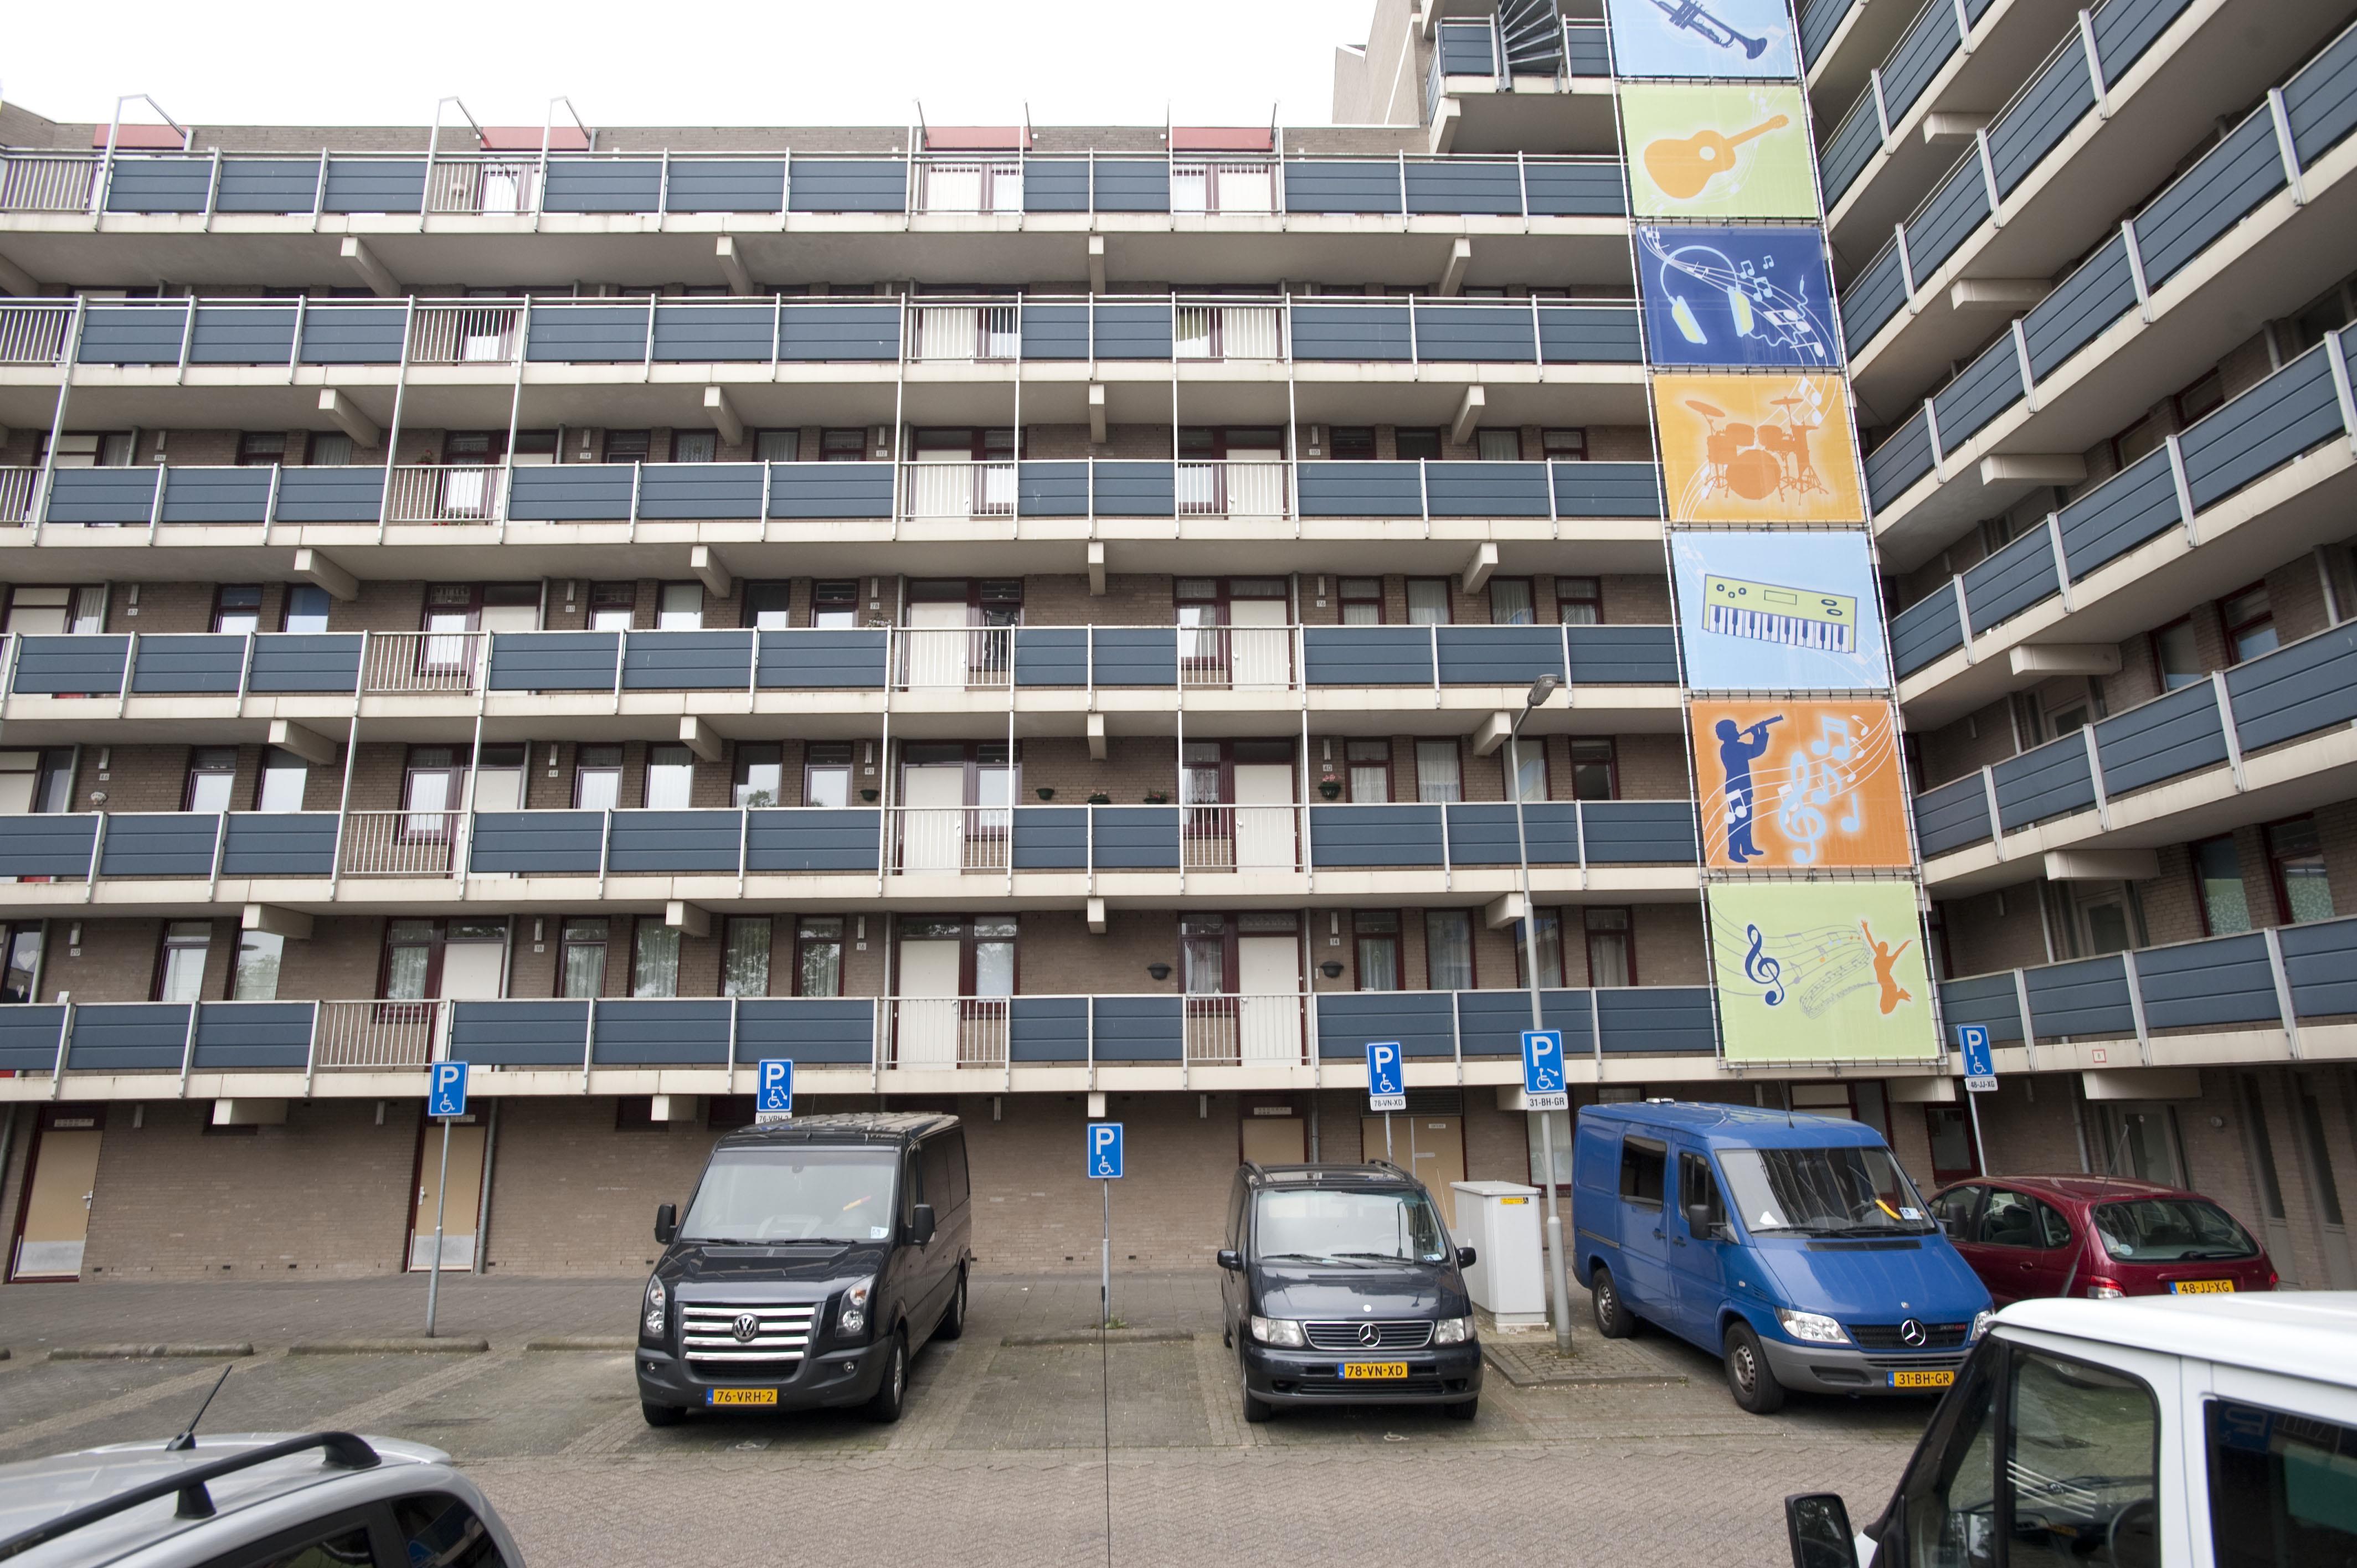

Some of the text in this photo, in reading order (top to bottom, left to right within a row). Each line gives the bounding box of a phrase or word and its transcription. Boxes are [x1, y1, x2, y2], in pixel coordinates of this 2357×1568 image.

[1531, 1036, 1553, 1067] P
[1967, 1030, 1983, 1055] P
[1375, 1046, 1393, 1073] P
[439, 1066, 459, 1092] P
[766, 1063, 785, 1090] P
[1374, 1098, 1403, 1107] 78-VN-XD
[1530, 1097, 1565, 1107] 31-BH-GR
[1096, 1128, 1115, 1155] P
[2181, 1281, 2229, 1294] 48-JJ-XG
[1347, 1365, 1403, 1376] 78-VN-XD
[1899, 1373, 1950, 1385] 31-BH-GR
[717, 1391, 774, 1402] 76-VRH-2
